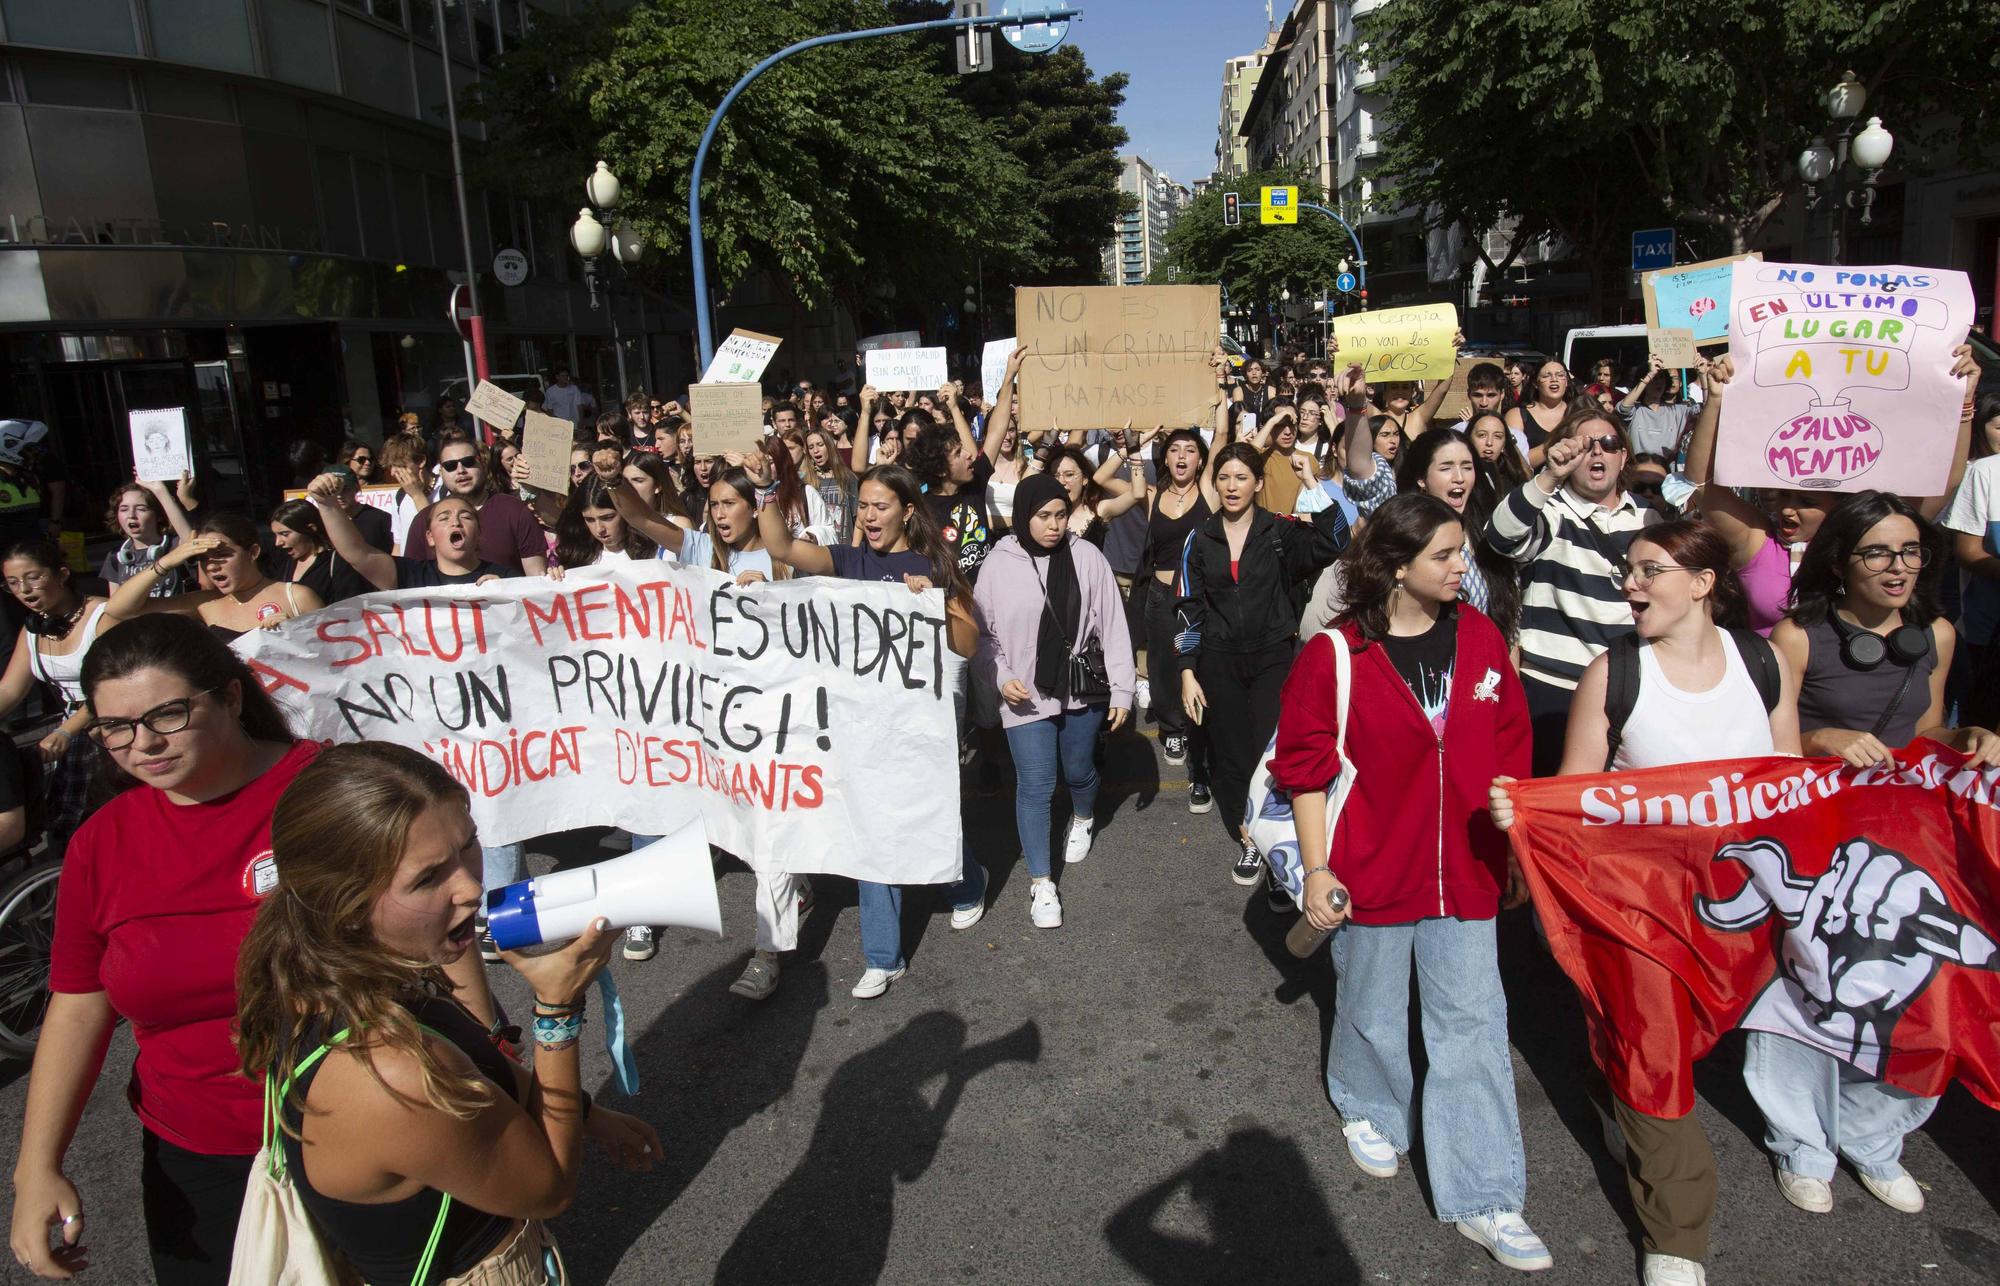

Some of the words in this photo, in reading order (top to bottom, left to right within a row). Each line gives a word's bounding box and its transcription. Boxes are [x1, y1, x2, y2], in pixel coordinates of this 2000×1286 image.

[0, 214, 170, 246] ICANTE
[1635, 242, 1672, 257] TAXI
[1777, 268, 1815, 285] NO
[1036, 290, 1086, 323] NO
[1121, 294, 1161, 320] ES
[1749, 298, 1789, 323] EN
[1351, 336, 1368, 348] no
[1376, 336, 1400, 347] van
[1409, 331, 1431, 347] los
[1784, 318, 1904, 343] LUGAR
[915, 350, 941, 361] SALUD
[1035, 331, 1088, 372] UN
[1364, 353, 1430, 374] LOCOS
[1785, 349, 1812, 379] A
[1839, 349, 1890, 376] TU
[872, 366, 889, 377] SIN
[893, 365, 921, 377] SALUD
[1043, 383, 1166, 411] TRATARSE
[1779, 415, 1872, 441] SALUD
[1768, 442, 1880, 478] MENTAL
[355, 493, 394, 508] ENTA
[248, 657, 309, 695] A
[317, 598, 488, 668] SALUT
[522, 582, 707, 651] MENTAL
[711, 579, 770, 660] ÉS
[781, 598, 841, 667] UN
[851, 602, 947, 700] DRET
[334, 673, 415, 741] NO
[430, 664, 512, 733] UN
